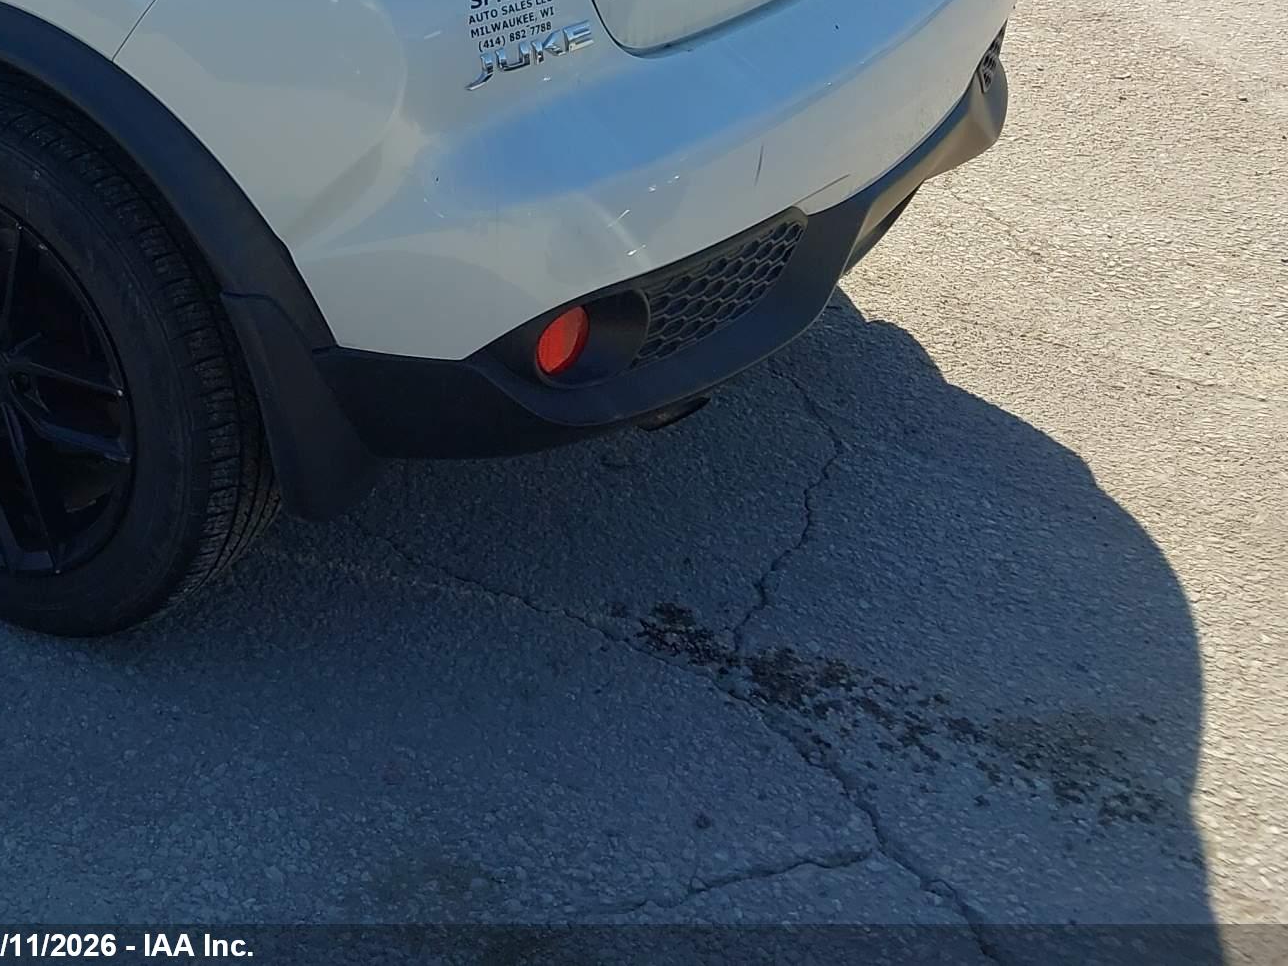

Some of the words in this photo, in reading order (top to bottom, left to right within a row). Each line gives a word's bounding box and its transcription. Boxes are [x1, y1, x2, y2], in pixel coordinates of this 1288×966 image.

[468, 9, 498, 25] AUTO
[470, 11, 538, 39] MILWAUKEE,
[540, 6, 555, 19] WI
[465, 19, 594, 91] JUKE
[478, 36, 506, 53] (414)
